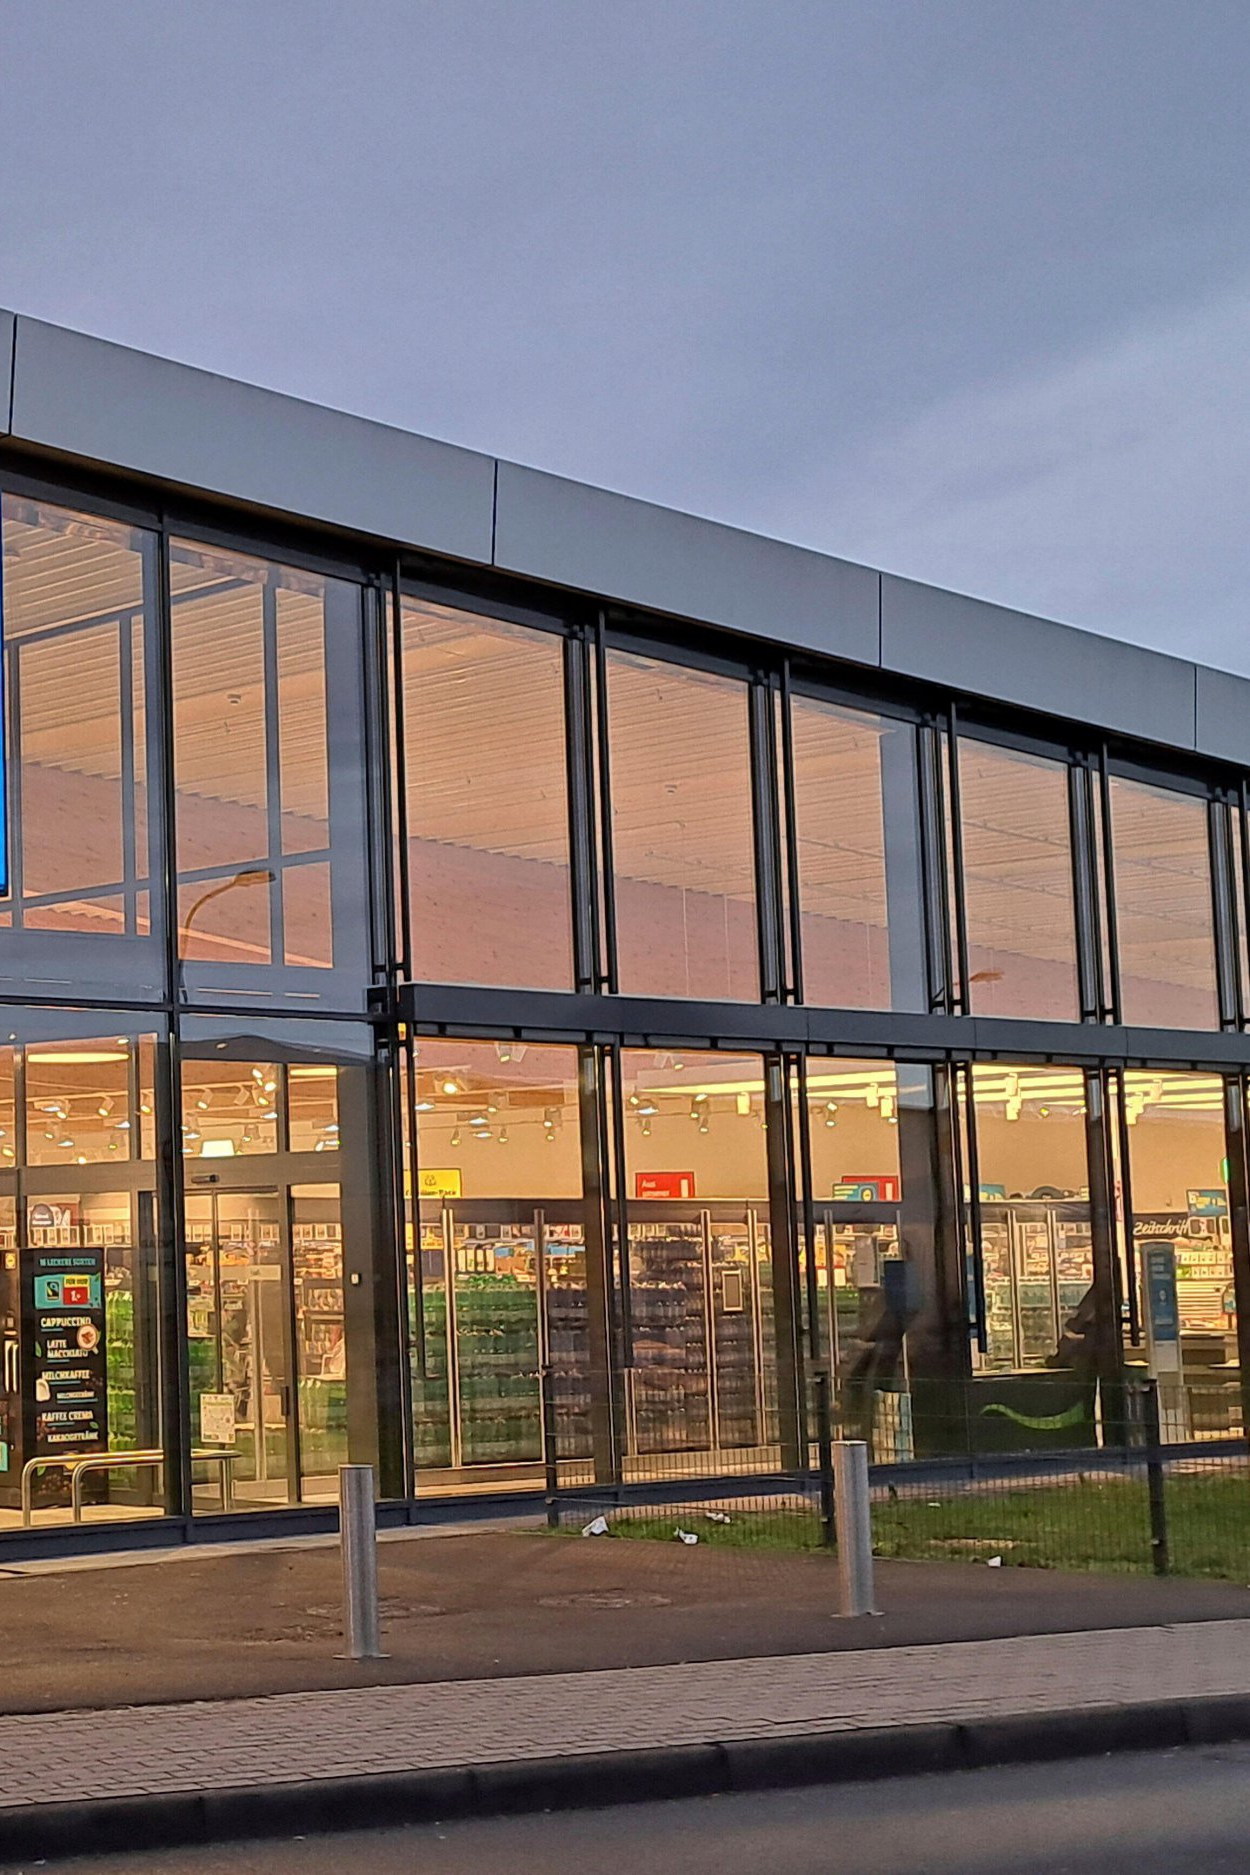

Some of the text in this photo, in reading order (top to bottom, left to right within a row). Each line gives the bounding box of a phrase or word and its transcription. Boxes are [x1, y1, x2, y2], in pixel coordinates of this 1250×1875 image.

[40, 1316, 92, 1328] CAPPUCCINO
[46, 1339, 67, 1349] LATTE
[41, 1369, 91, 1380] MILCHKAFFEE
[41, 1411, 68, 1421] KAFFEE
